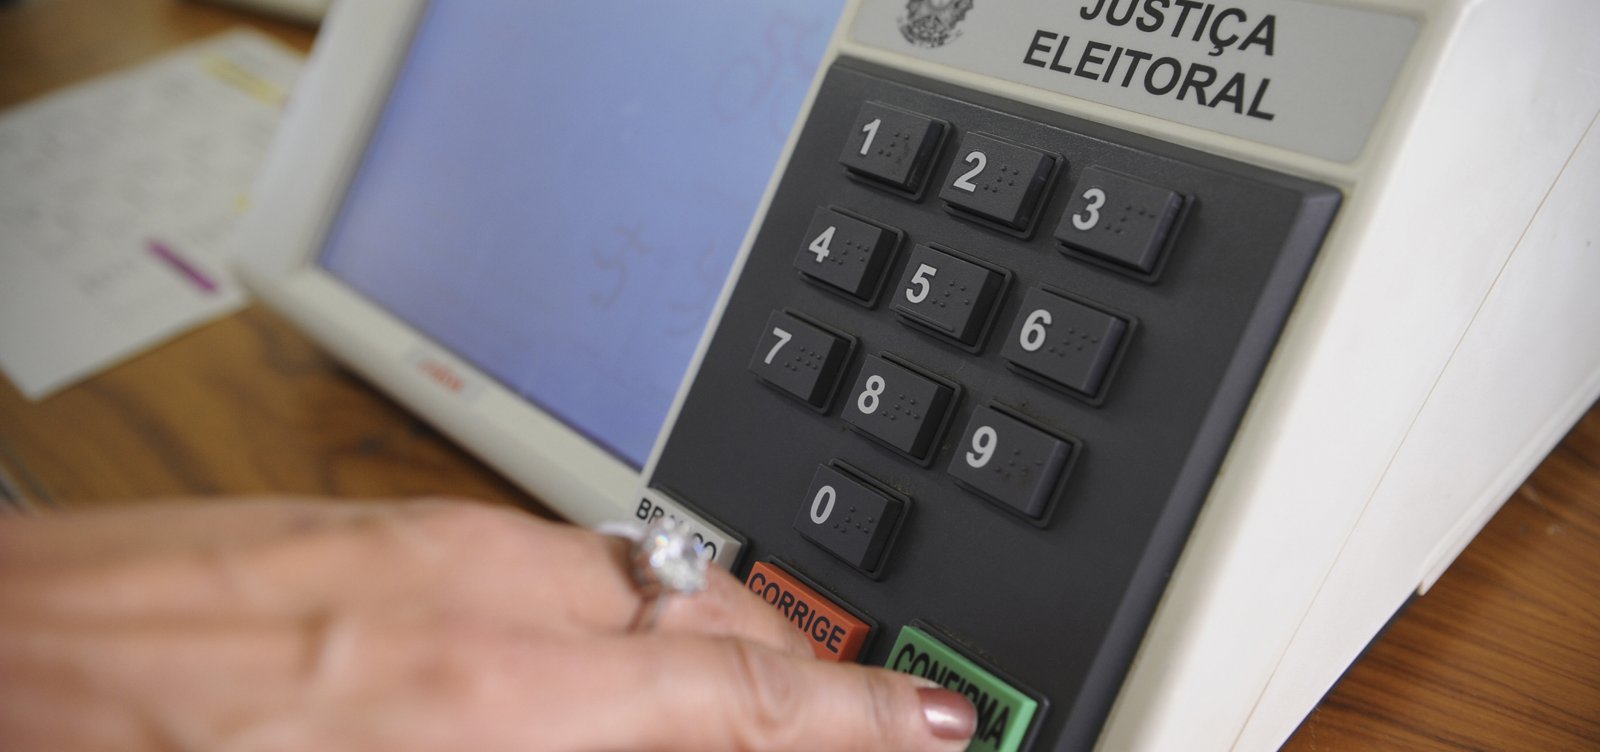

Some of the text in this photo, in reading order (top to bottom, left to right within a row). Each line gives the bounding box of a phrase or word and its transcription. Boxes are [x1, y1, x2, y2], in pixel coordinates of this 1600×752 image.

[1080, 0, 1276, 57] JUSTIÇA
[1023, 30, 1275, 121] ELEITORAL
[860, 118, 882, 155] 1
[953, 151, 987, 193] 2
[1072, 188, 1106, 231] 3
[808, 226, 836, 263] 4
[905, 263, 937, 304] 5
[764, 327, 793, 365] 7
[1019, 309, 1052, 352] 6
[857, 374, 886, 415] 8
[965, 425, 998, 468] 9
[810, 485, 837, 525] 0
[636, 497, 717, 561] BRO
[749, 572, 847, 654] CORRIGE
